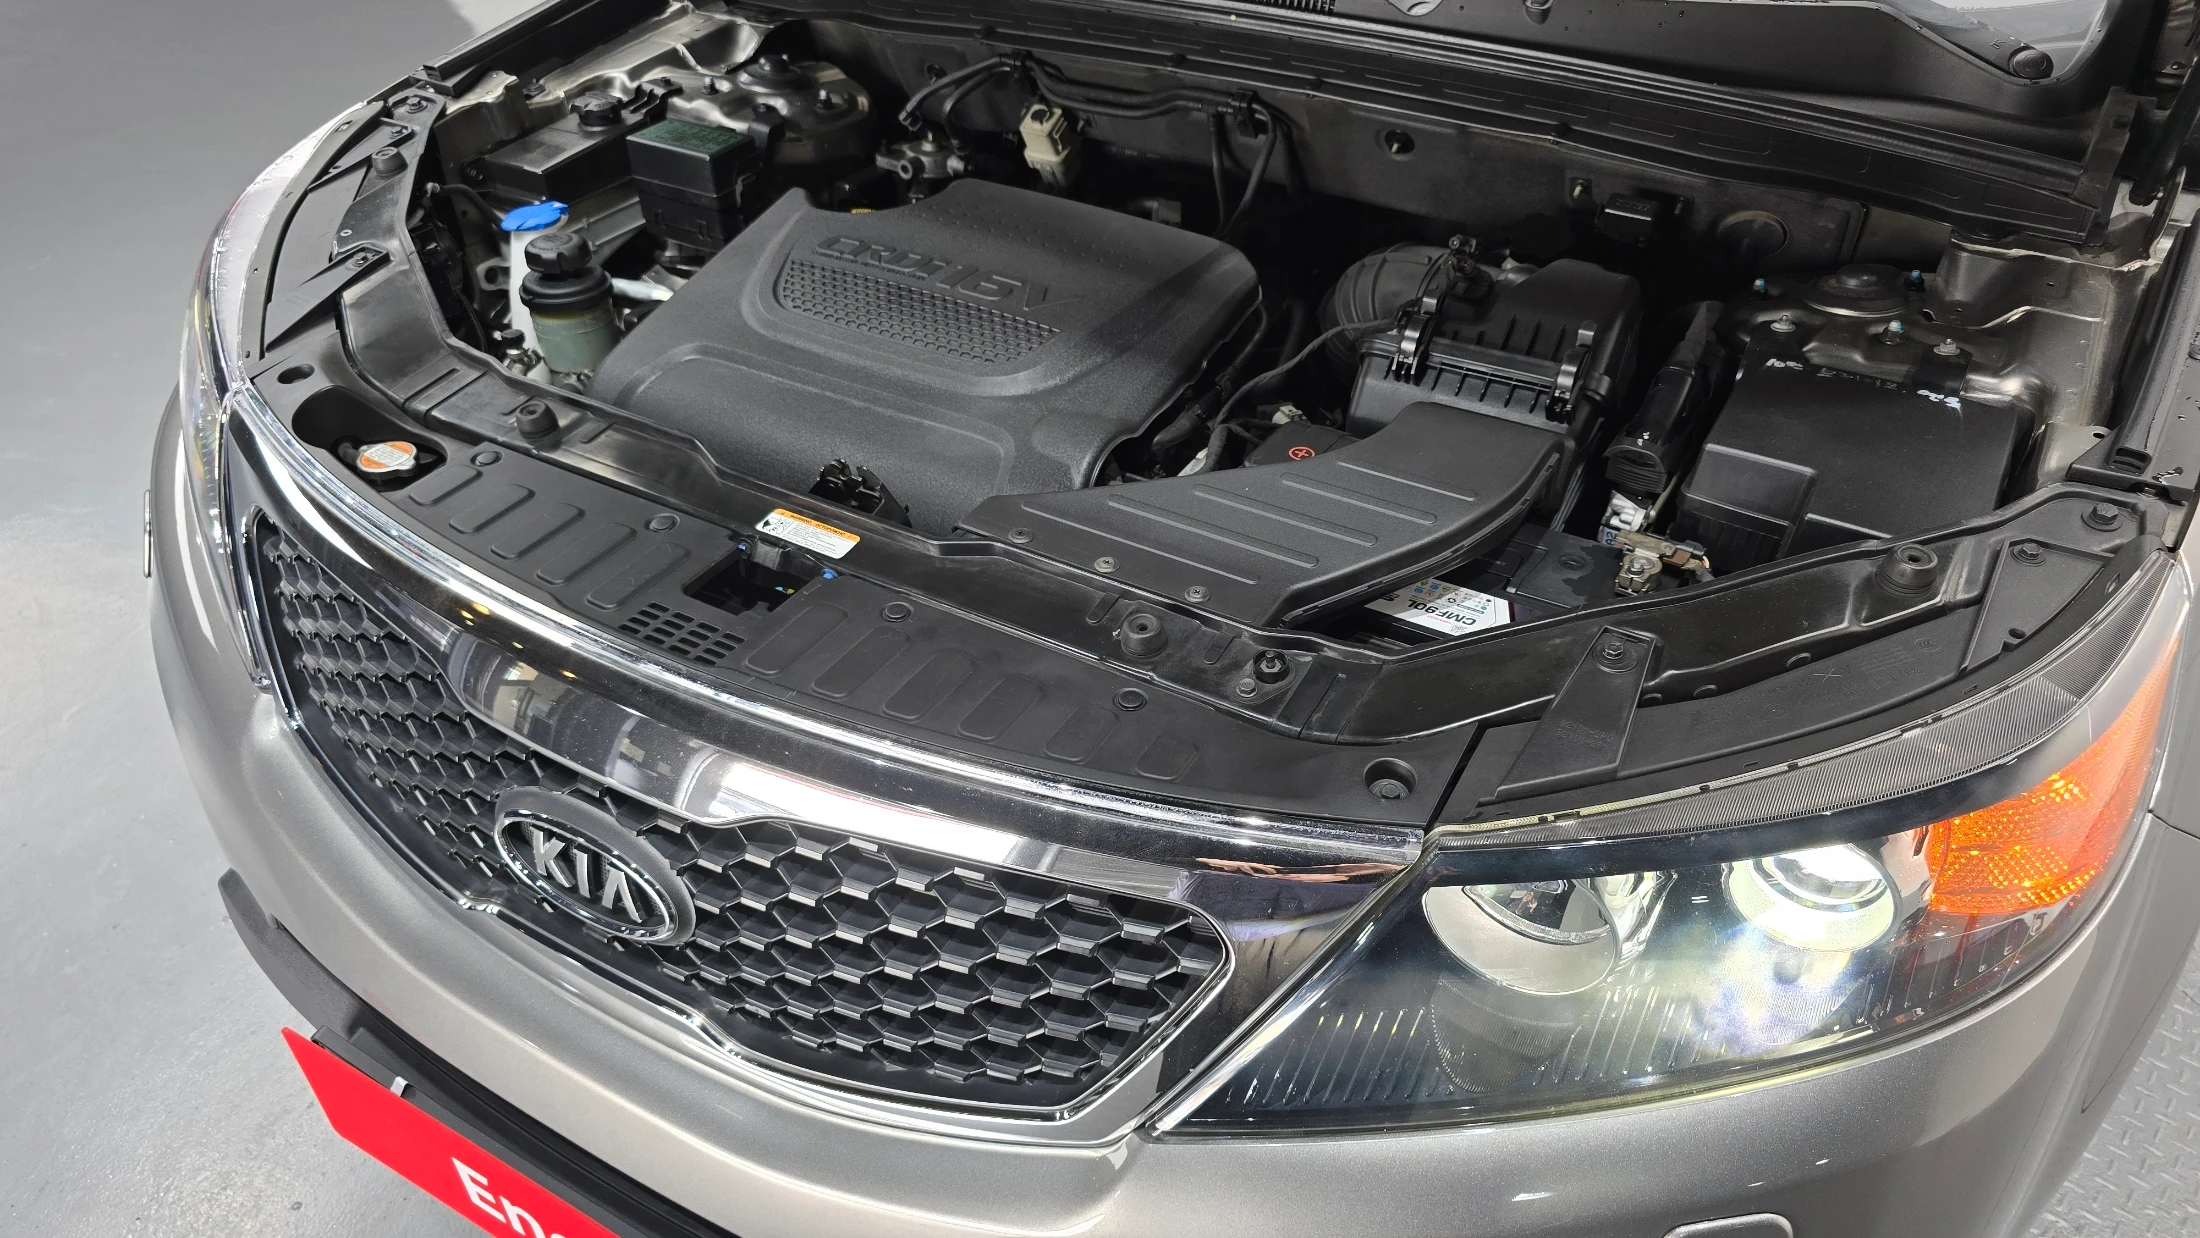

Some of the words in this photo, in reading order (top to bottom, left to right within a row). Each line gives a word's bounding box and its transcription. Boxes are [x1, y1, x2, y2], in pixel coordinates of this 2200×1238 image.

[1408, 598, 1477, 627] CMF90L
[529, 825, 645, 924] KIA
[451, 1156, 567, 1238] En
